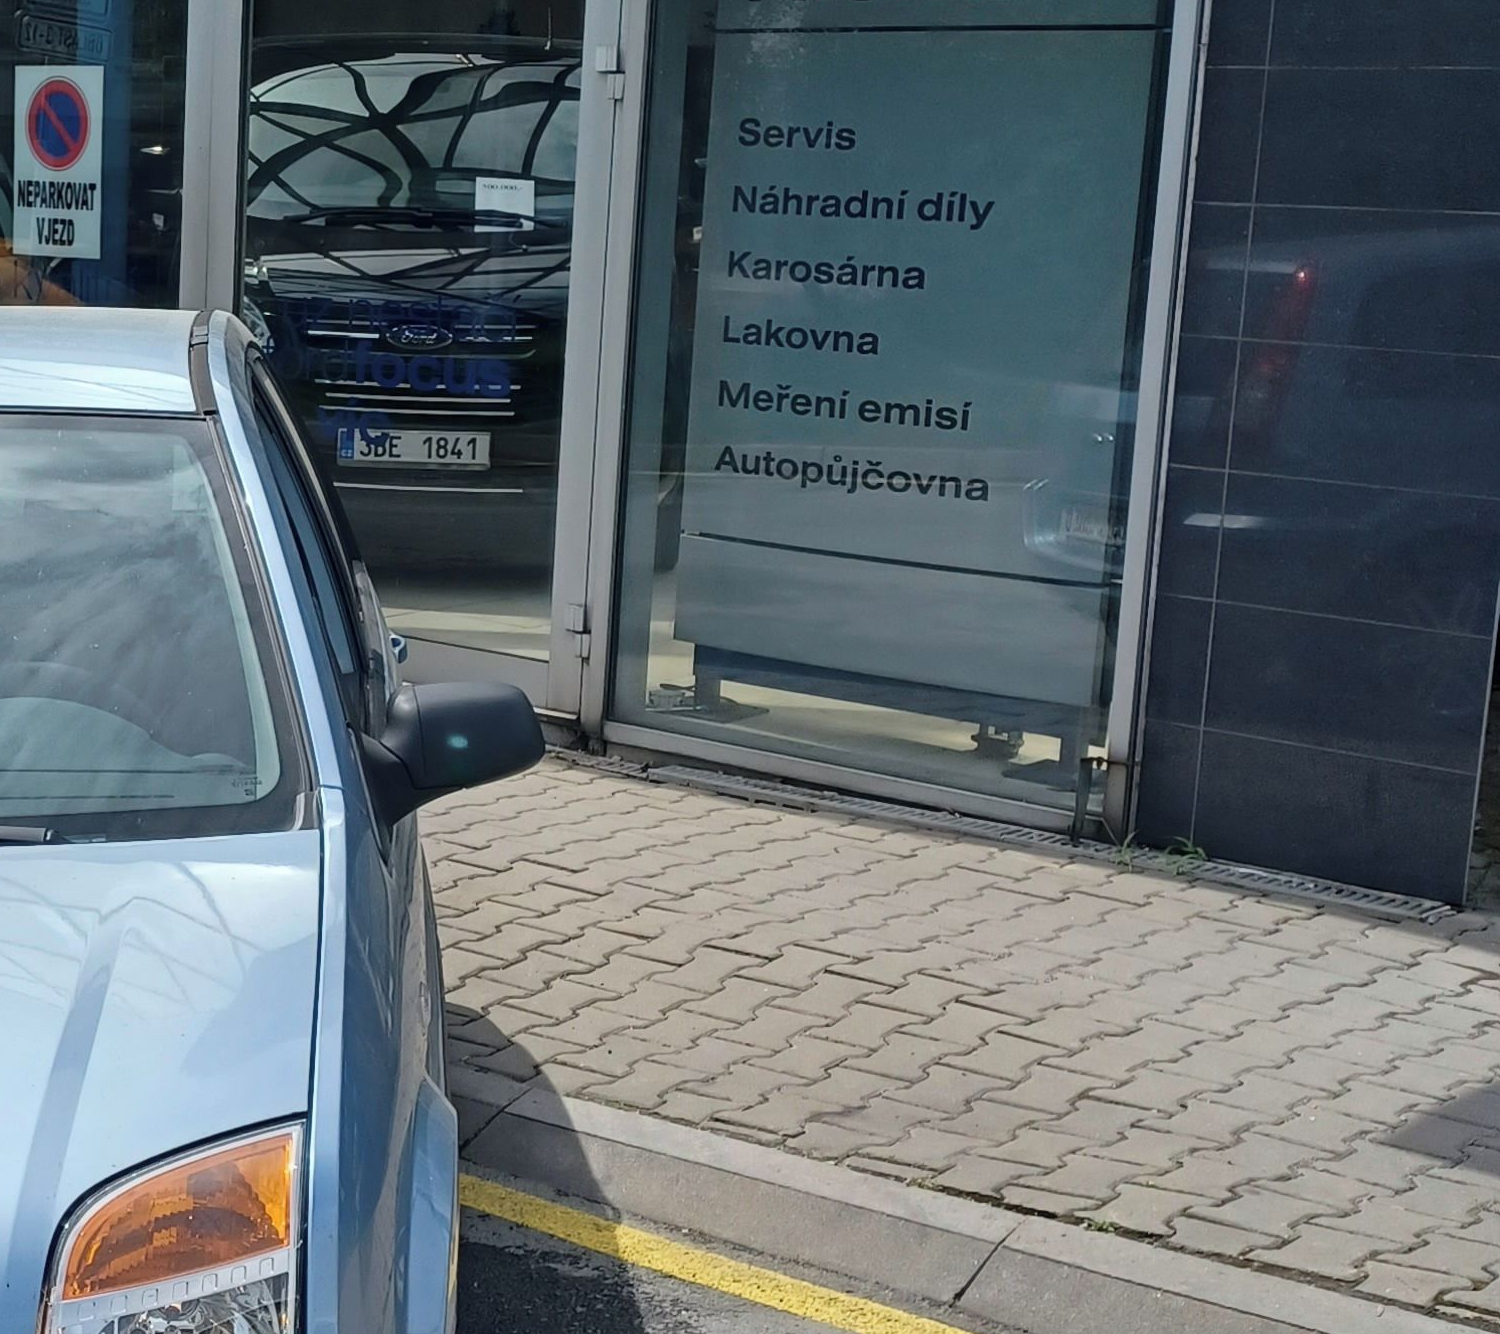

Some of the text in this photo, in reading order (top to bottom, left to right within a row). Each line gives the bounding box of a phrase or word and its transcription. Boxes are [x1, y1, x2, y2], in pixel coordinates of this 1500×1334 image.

[739, 117, 857, 151] Servis
[17, 179, 97, 212] NEPARKOVAT
[732, 185, 996, 231] Náhradní díly
[36, 216, 75, 247] VJEZD
[727, 250, 926, 291] Karosárna
[723, 315, 880, 356] Lakovna
[718, 379, 972, 432] Meření emisí
[422, 436, 478, 461] 1841
[715, 445, 990, 502] Autopůjčovna
